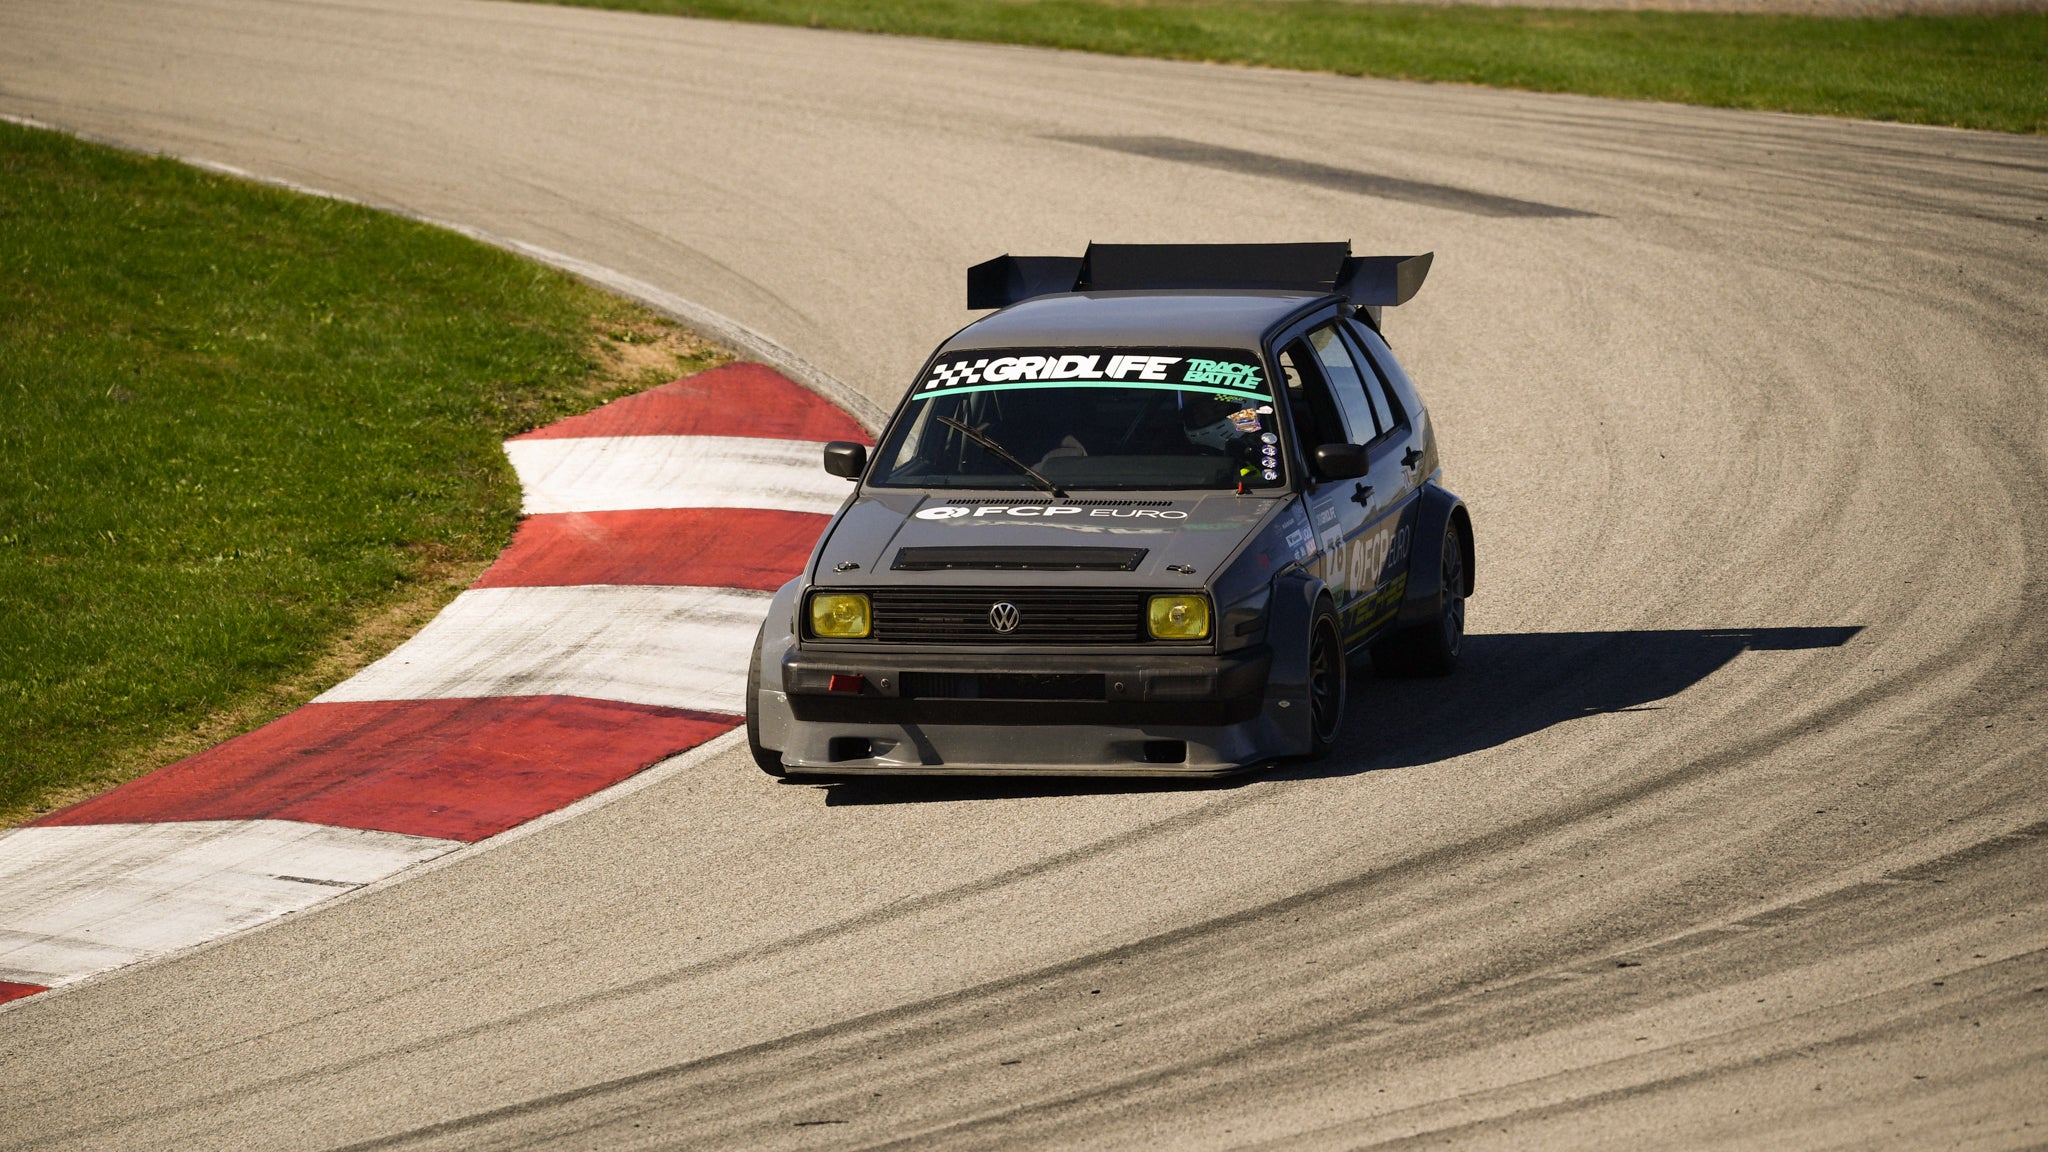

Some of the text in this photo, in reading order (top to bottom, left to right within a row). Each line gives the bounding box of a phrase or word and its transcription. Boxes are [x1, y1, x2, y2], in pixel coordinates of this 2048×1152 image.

[983, 355, 1183, 381] GRIDLIFE
[1186, 358, 1261, 379] TRACK
[1184, 371, 1264, 390] BATTLE
[973, 506, 1188, 519] FCP EURO
[1362, 528, 1389, 586] FCP
